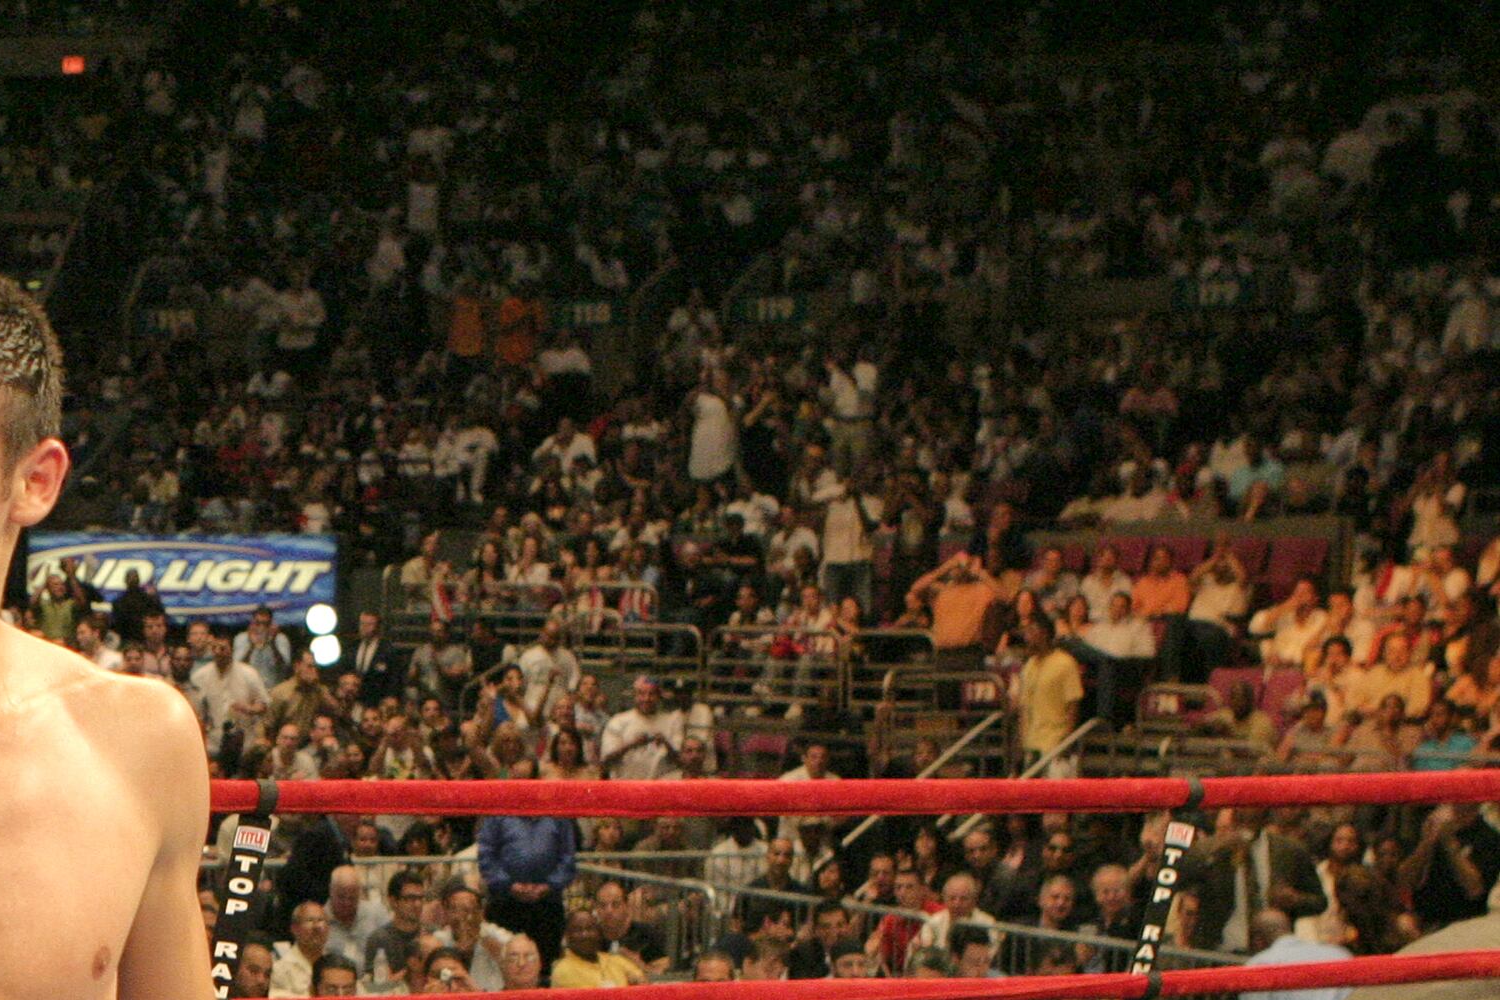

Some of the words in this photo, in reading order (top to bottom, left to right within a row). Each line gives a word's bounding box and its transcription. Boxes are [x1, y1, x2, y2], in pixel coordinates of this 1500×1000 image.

[156, 559, 331, 593] LIGHT
[225, 854, 259, 916] TOP
[1153, 847, 1182, 903] TOP
[211, 940, 239, 1000] RAN
